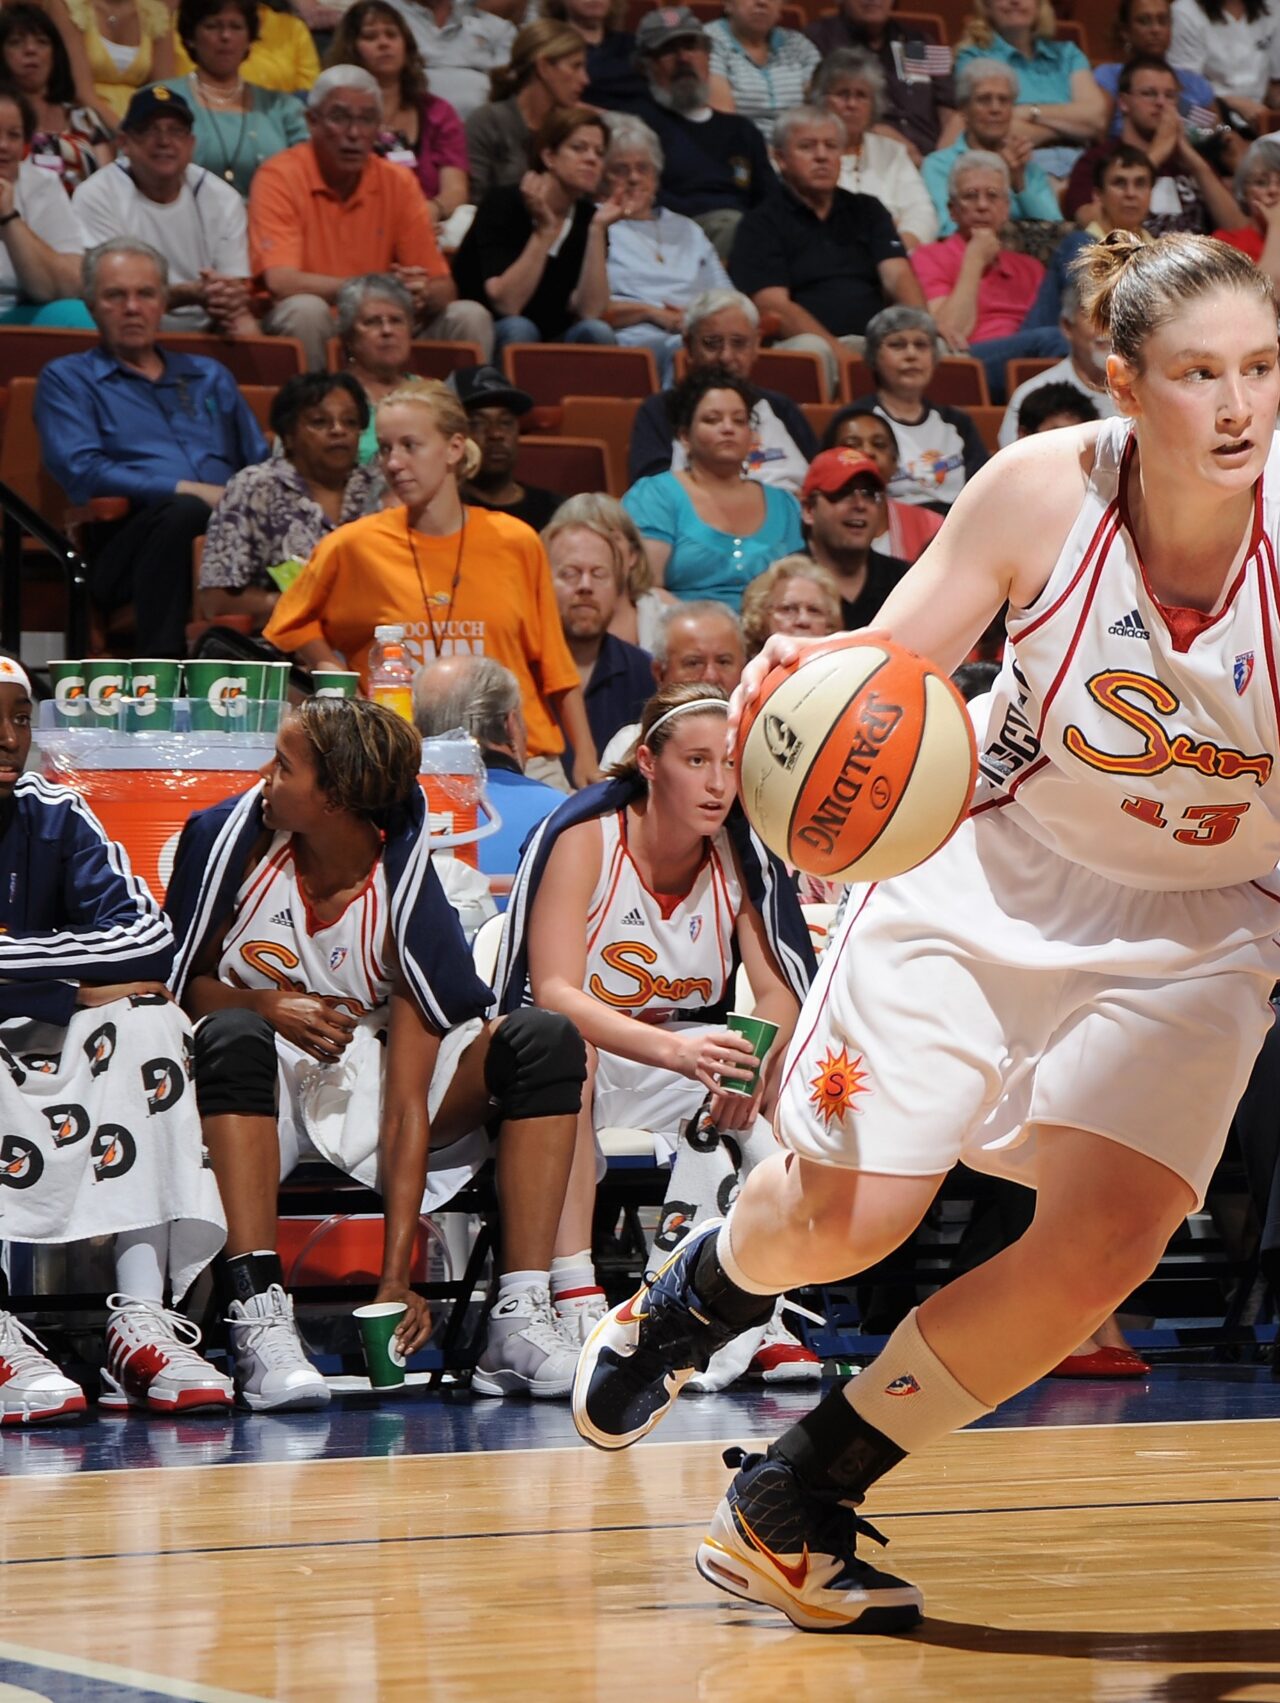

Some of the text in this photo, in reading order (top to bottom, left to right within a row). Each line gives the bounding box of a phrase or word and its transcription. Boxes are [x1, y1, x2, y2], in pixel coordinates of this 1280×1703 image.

[1108, 624, 1150, 641] adidas
[88, 675, 123, 716] G
[1063, 668, 1273, 787] Sun
[797, 692, 903, 855] SPALDING
[1121, 792, 1250, 846] 13
[590, 941, 713, 1007] Sun
[825, 1073, 845, 1097] S
